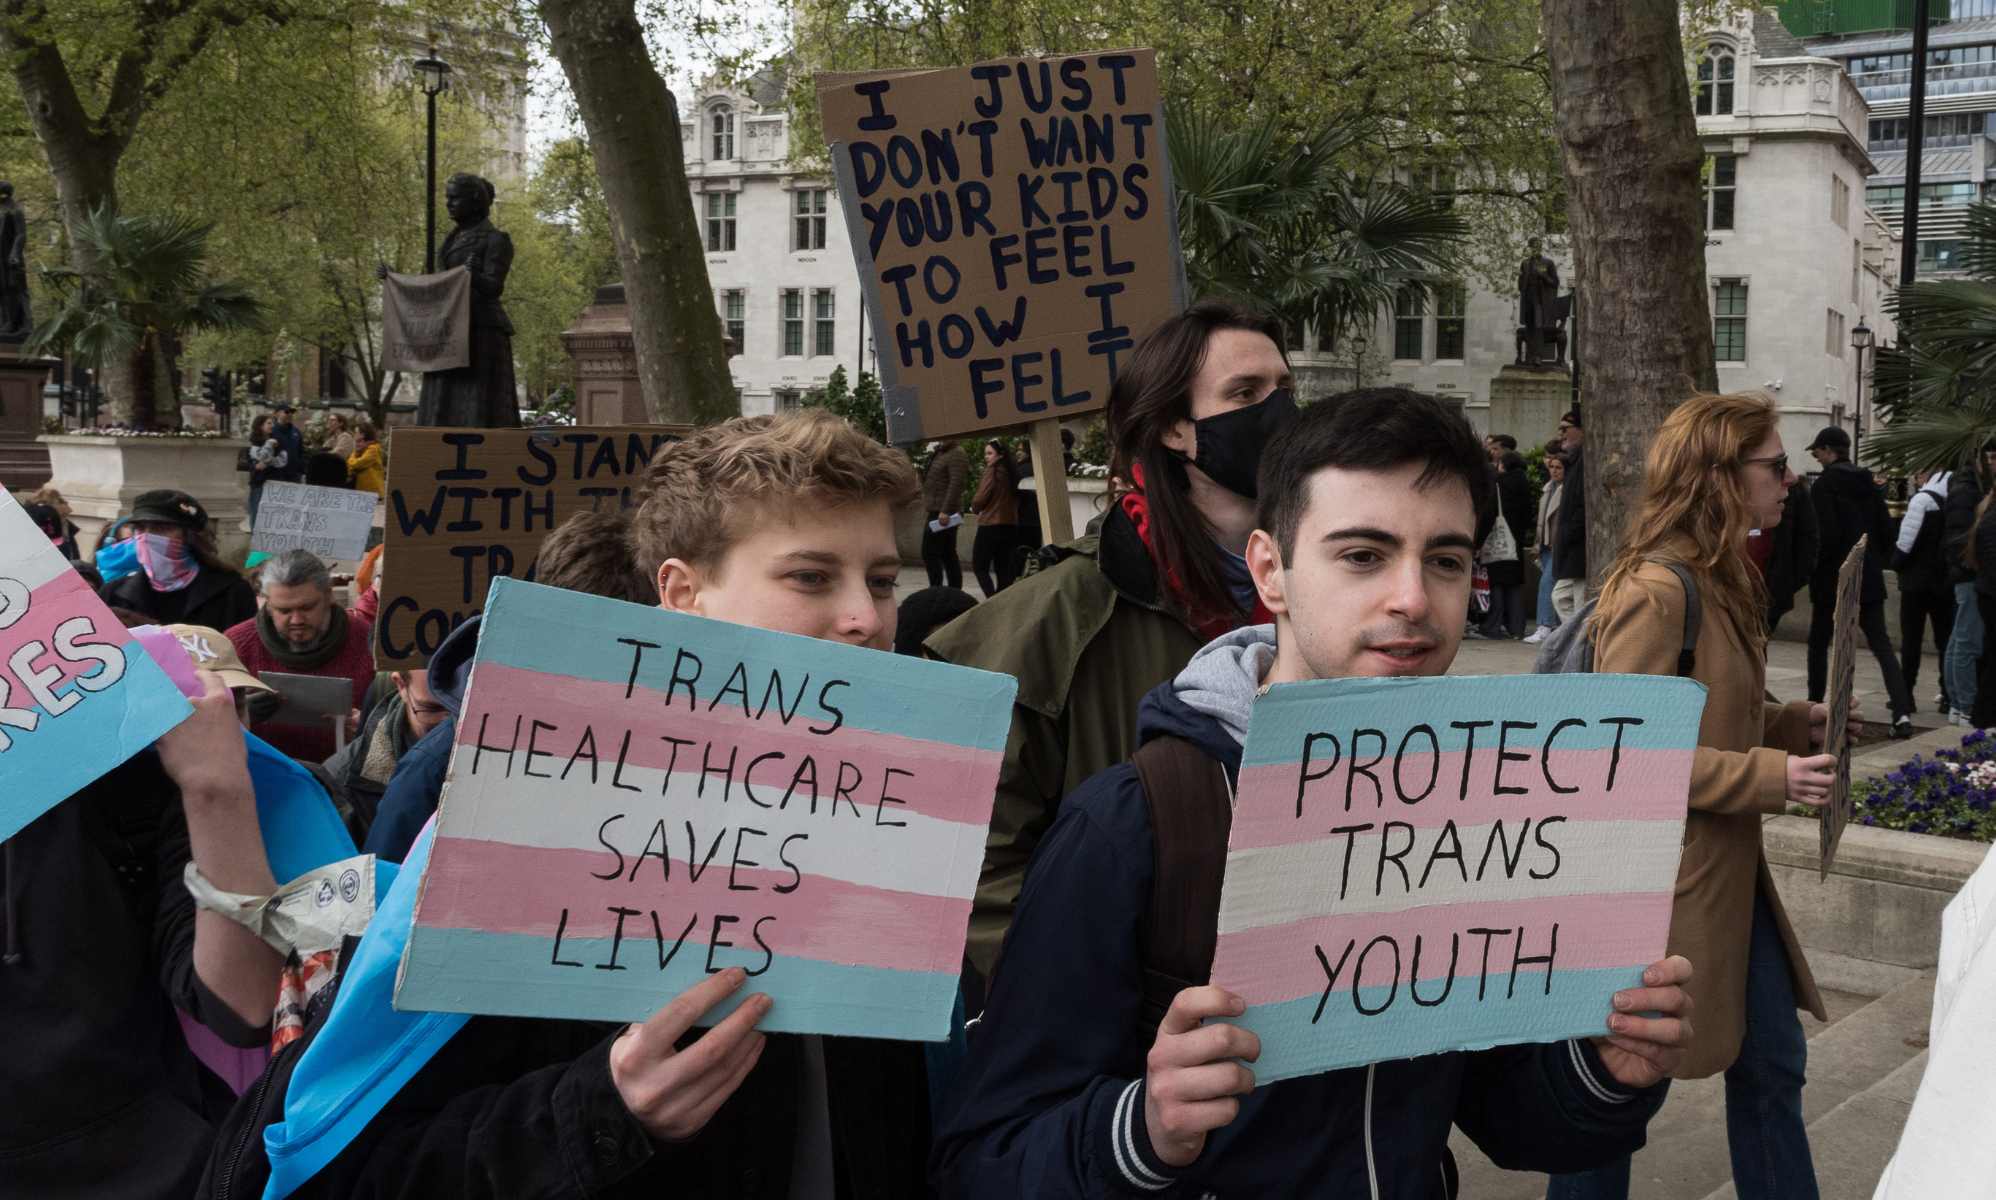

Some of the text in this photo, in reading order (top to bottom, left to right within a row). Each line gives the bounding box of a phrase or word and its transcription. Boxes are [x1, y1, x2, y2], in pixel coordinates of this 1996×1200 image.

[854, 55, 1136, 131] I JUST
[850, 114, 1152, 197] DON'T WANT
[860, 163, 1149, 262] YOUR KIDS
[881, 224, 1135, 316] TO FEEL
[896, 282, 1130, 368] HOW I
[969, 338, 1134, 419] FELT
[301, 487, 345, 509] ARE
[435, 433, 487, 481] I
[258, 531, 337, 557] YOUTH
[261, 503, 329, 533] TRANS
[391, 485, 554, 537] WITH
[617, 638, 851, 735] TRANS
[472, 713, 915, 827] HEALTHCARE
[1296, 717, 1644, 819] PROTECT
[590, 814, 809, 894] SAVES
[1330, 815, 1567, 900] TRANS
[552, 906, 777, 976] LIVES
[1312, 923, 1559, 1024] YOUTH
